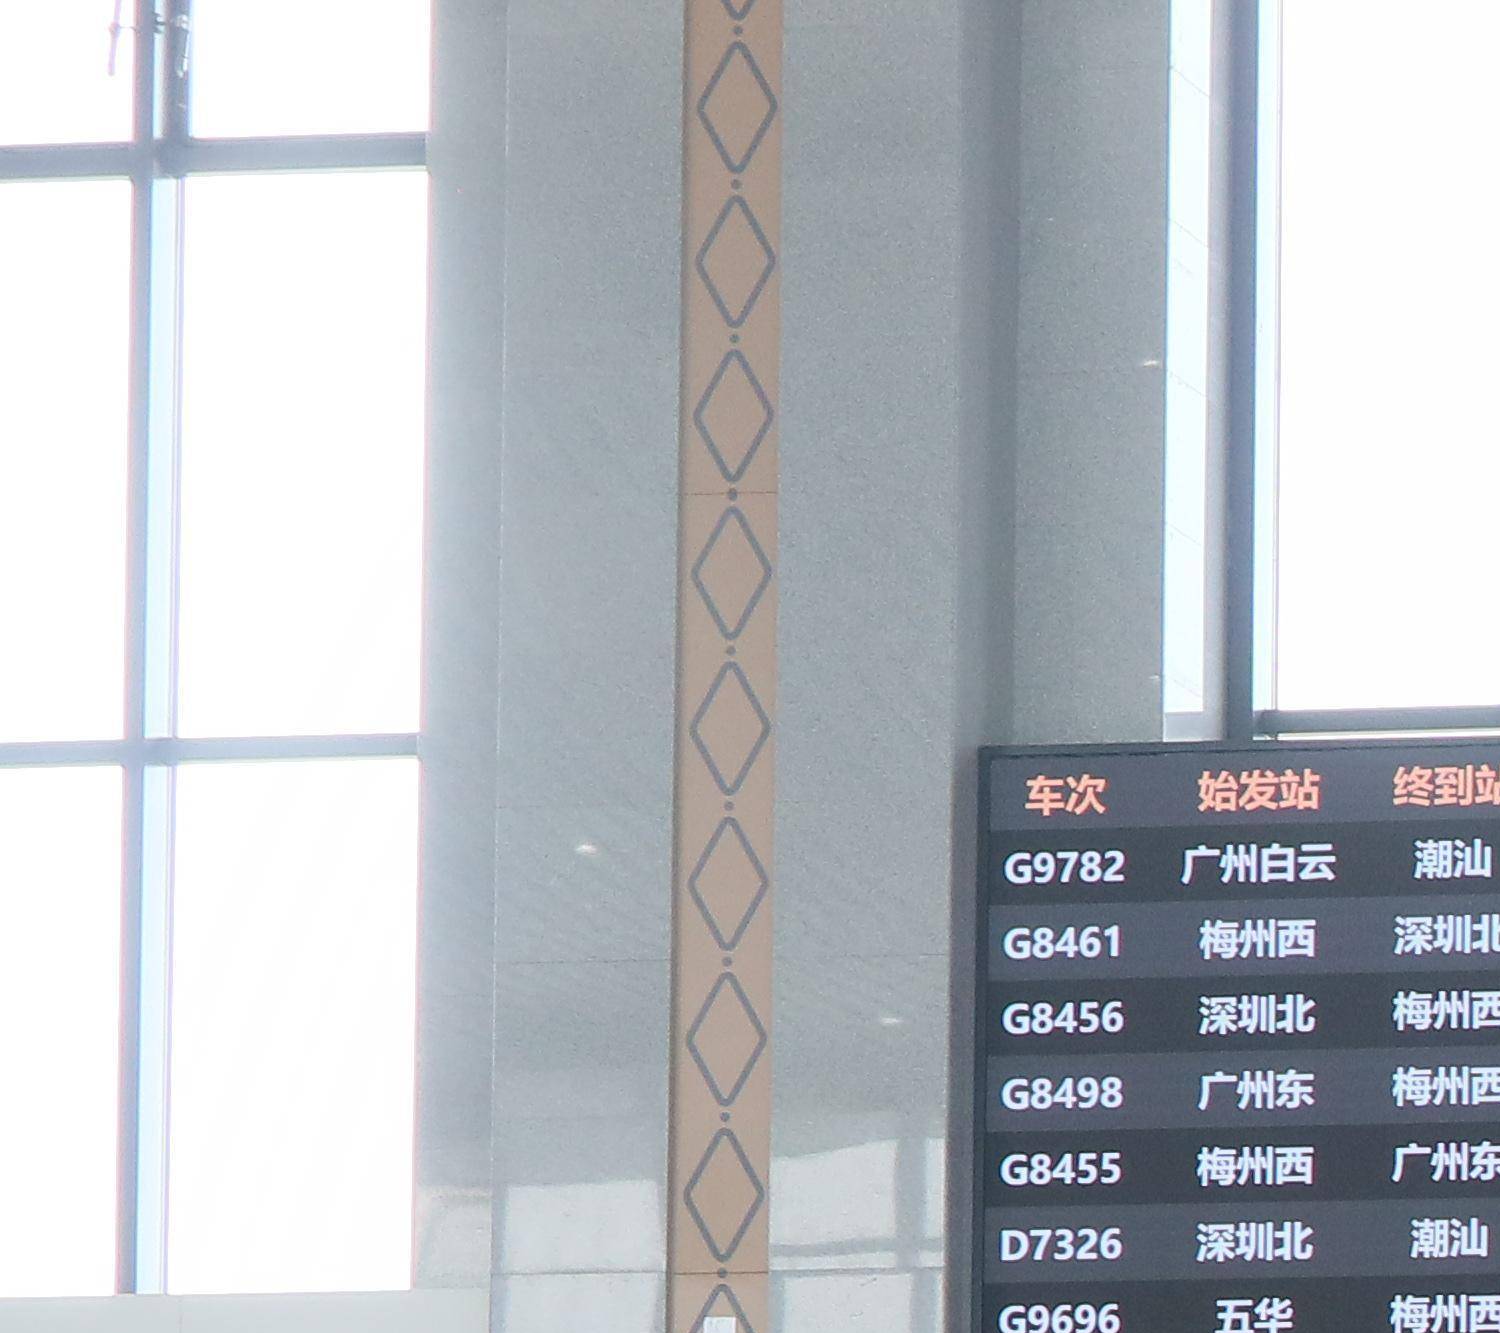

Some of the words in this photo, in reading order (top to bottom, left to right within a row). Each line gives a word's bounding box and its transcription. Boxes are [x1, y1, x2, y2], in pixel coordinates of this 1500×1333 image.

[1025, 775, 1106, 816] 车次
[1198, 769, 1320, 811] 始发站
[1006, 851, 1124, 883] G9782
[1183, 844, 1335, 883] 广州白云
[1415, 839, 1491, 878] 潮汕
[1005, 926, 1119, 958] G8461
[1200, 919, 1316, 959] 梅州西
[1004, 1002, 1123, 1034] G8456
[1200, 995, 1315, 1034] 深圳北
[1003, 1077, 1122, 1109] G8498
[1199, 1070, 1314, 1109] 广州东
[1002, 1153, 1120, 1185] G8455
[1198, 1147, 1313, 1186] 梅州西
[1002, 1228, 1122, 1260] D7326
[1197, 1222, 1313, 1261] 深圳北
[1411, 1218, 1487, 1258] 潮汕
